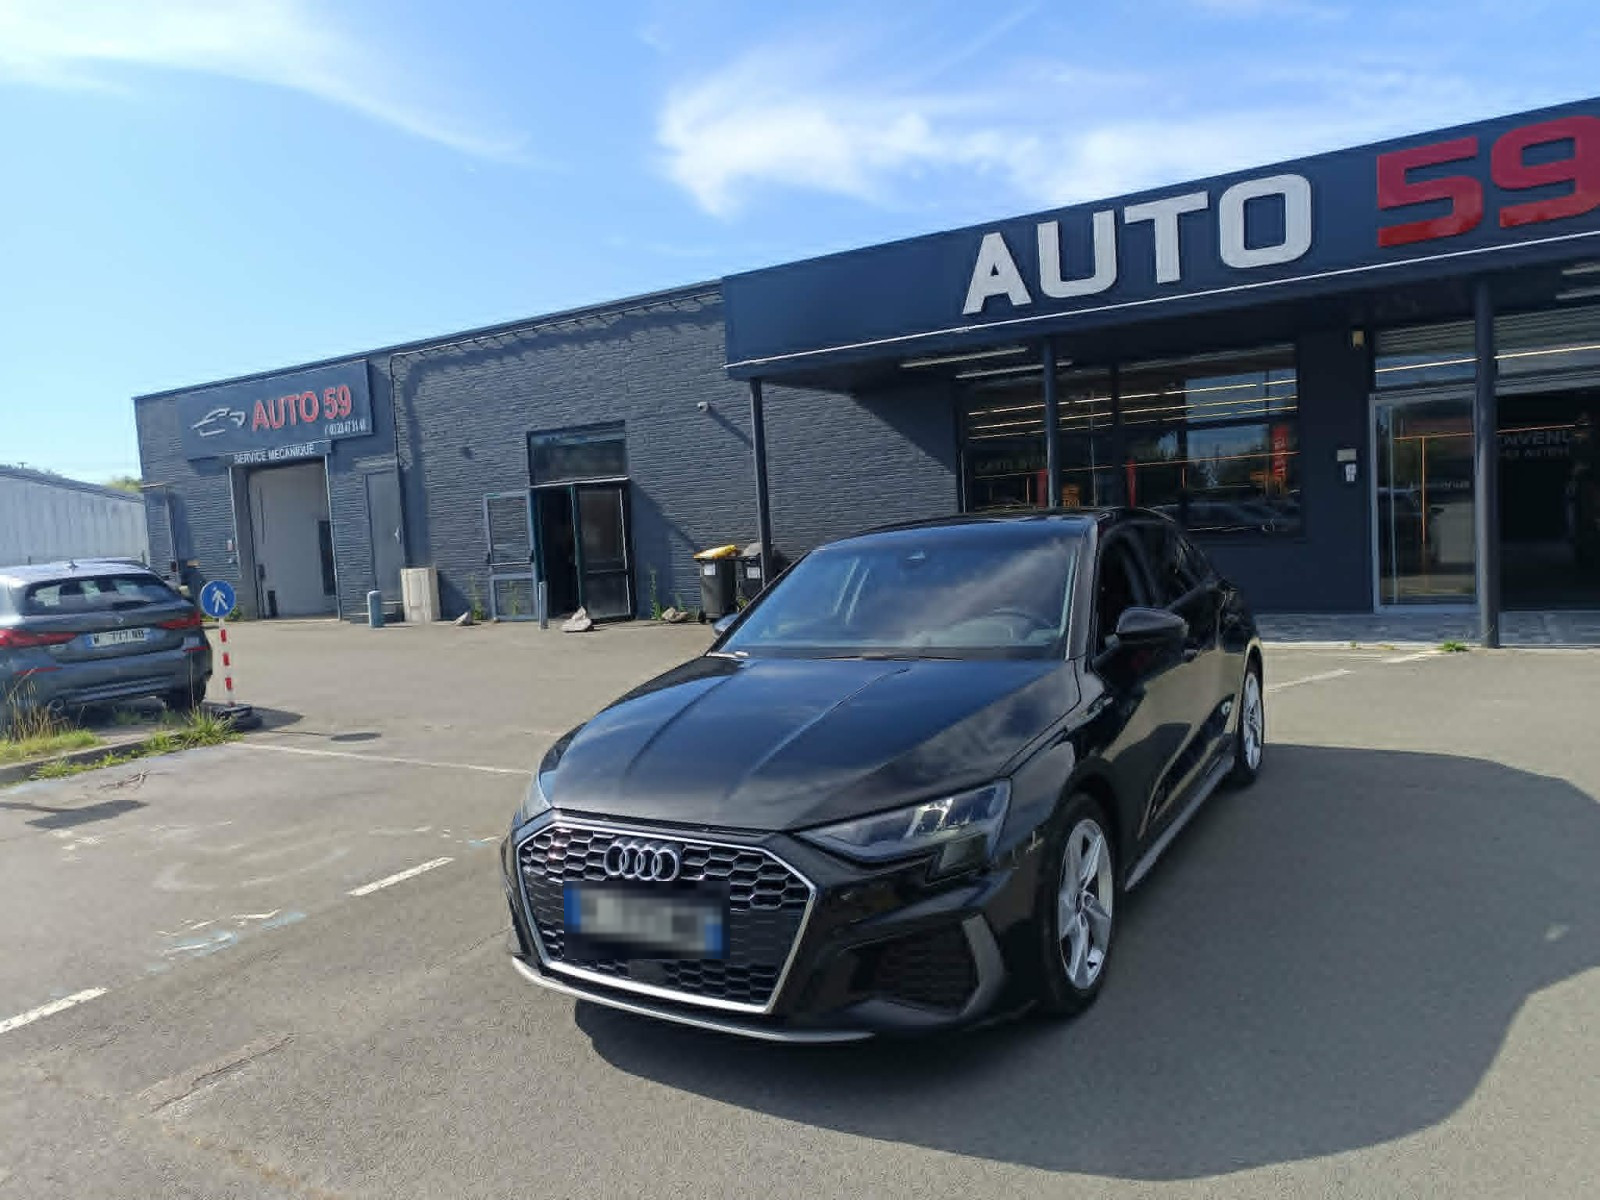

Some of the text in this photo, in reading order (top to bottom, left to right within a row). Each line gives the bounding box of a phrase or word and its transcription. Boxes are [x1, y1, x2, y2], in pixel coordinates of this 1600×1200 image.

[963, 115, 1600, 315] AUTO 59
[253, 384, 352, 431] AUTO 59
[234, 452, 268, 465] SERVICE
